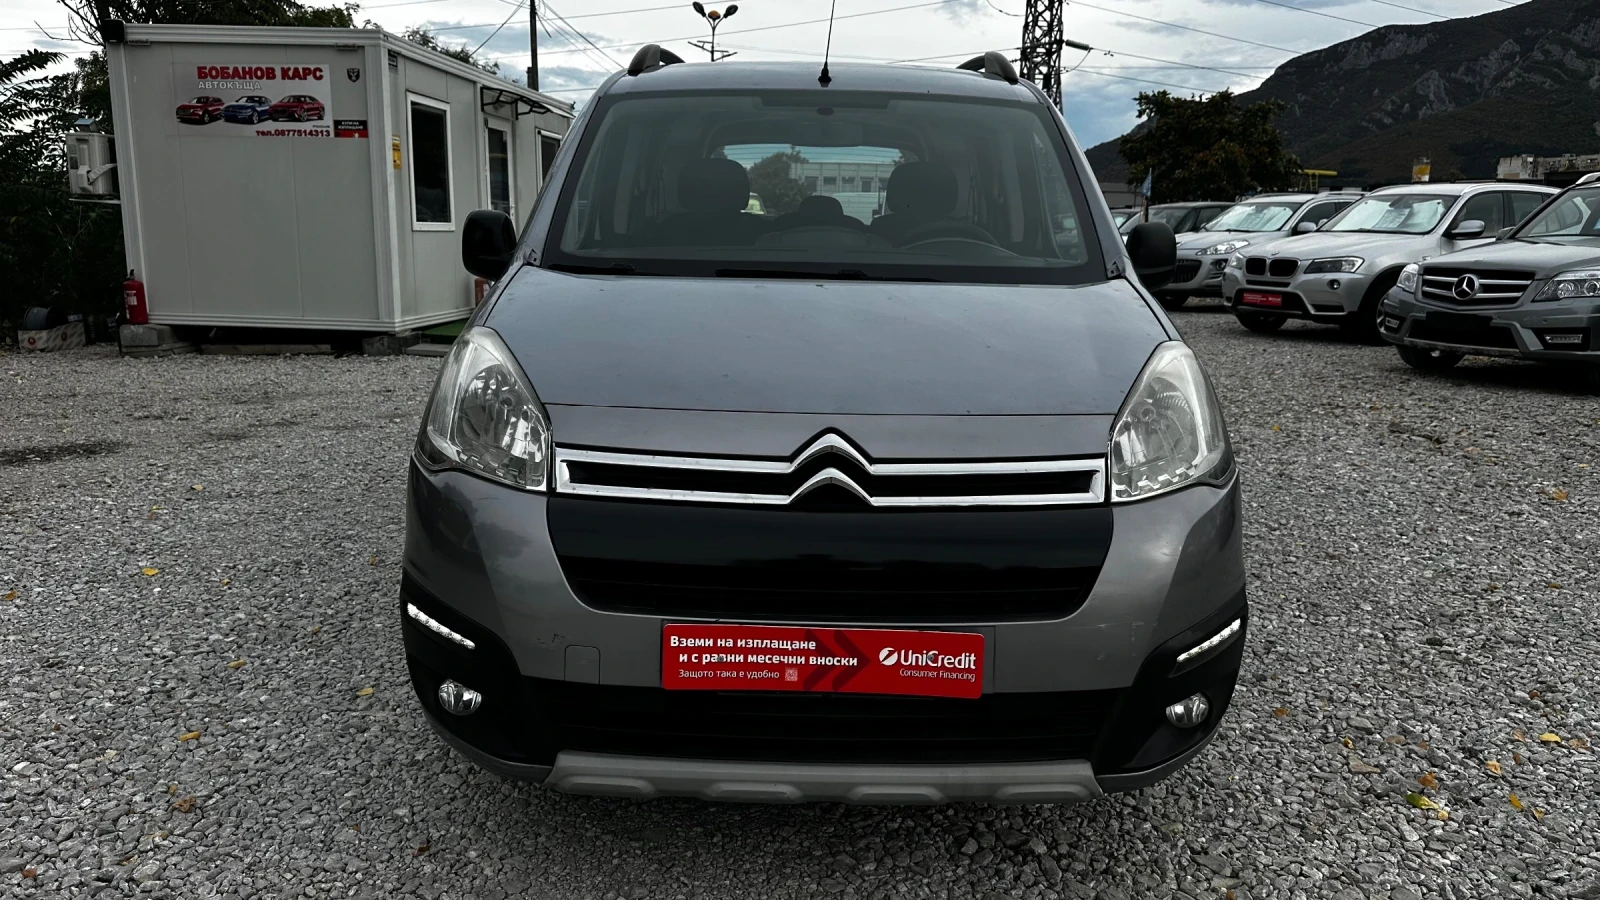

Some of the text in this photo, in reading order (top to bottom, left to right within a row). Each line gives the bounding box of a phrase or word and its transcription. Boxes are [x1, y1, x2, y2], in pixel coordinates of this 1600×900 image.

[197, 66, 324, 81] БОБАНОВ КАРС
[198, 81, 262, 91] АВТОКЪЩА
[256, 129, 331, 137] тел.0877514313
[670, 635, 816, 651] Вземи на изплащане
[679, 653, 688, 663] и
[691, 653, 699, 663] с
[747, 654, 806, 665] месечни
[809, 656, 858, 666] вноски
[900, 649, 976, 669] UniCredit
[678, 669, 780, 679] Защото така е удобно
[899, 668, 976, 683] Consumer Financing
